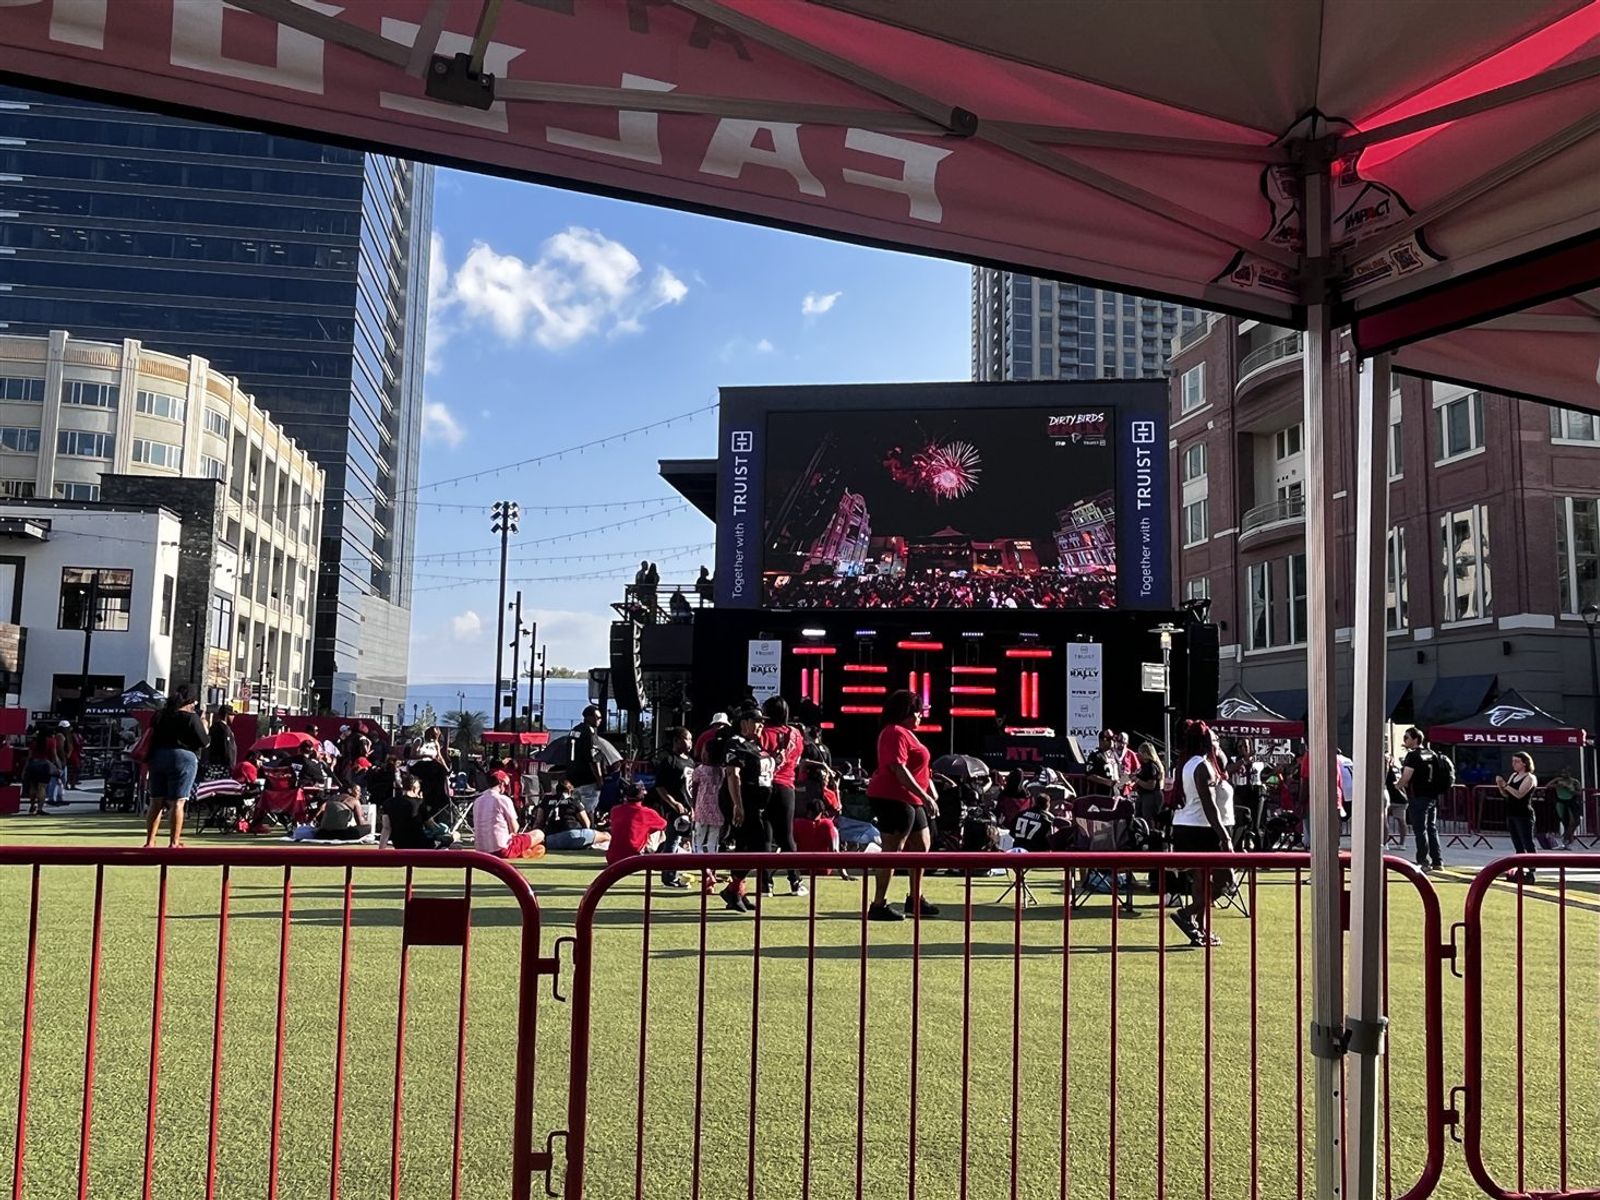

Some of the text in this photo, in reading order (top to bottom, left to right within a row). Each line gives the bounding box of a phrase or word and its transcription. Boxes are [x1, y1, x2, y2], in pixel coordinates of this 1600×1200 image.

[1344, 198, 1391, 230] IMPACT
[1048, 412, 1105, 426] DIRTY BIRDS
[732, 456, 748, 599] Together with TRUIST
[1136, 447, 1154, 597] Together with TRUIST
[1070, 670, 1099, 678] RALLY
[1070, 729, 1100, 737] RALLY
[1210, 726, 1271, 735] ALCONS
[1463, 733, 1544, 744] FALCONS
[1005, 746, 1044, 762] ATL
[1015, 816, 1042, 840] 97
